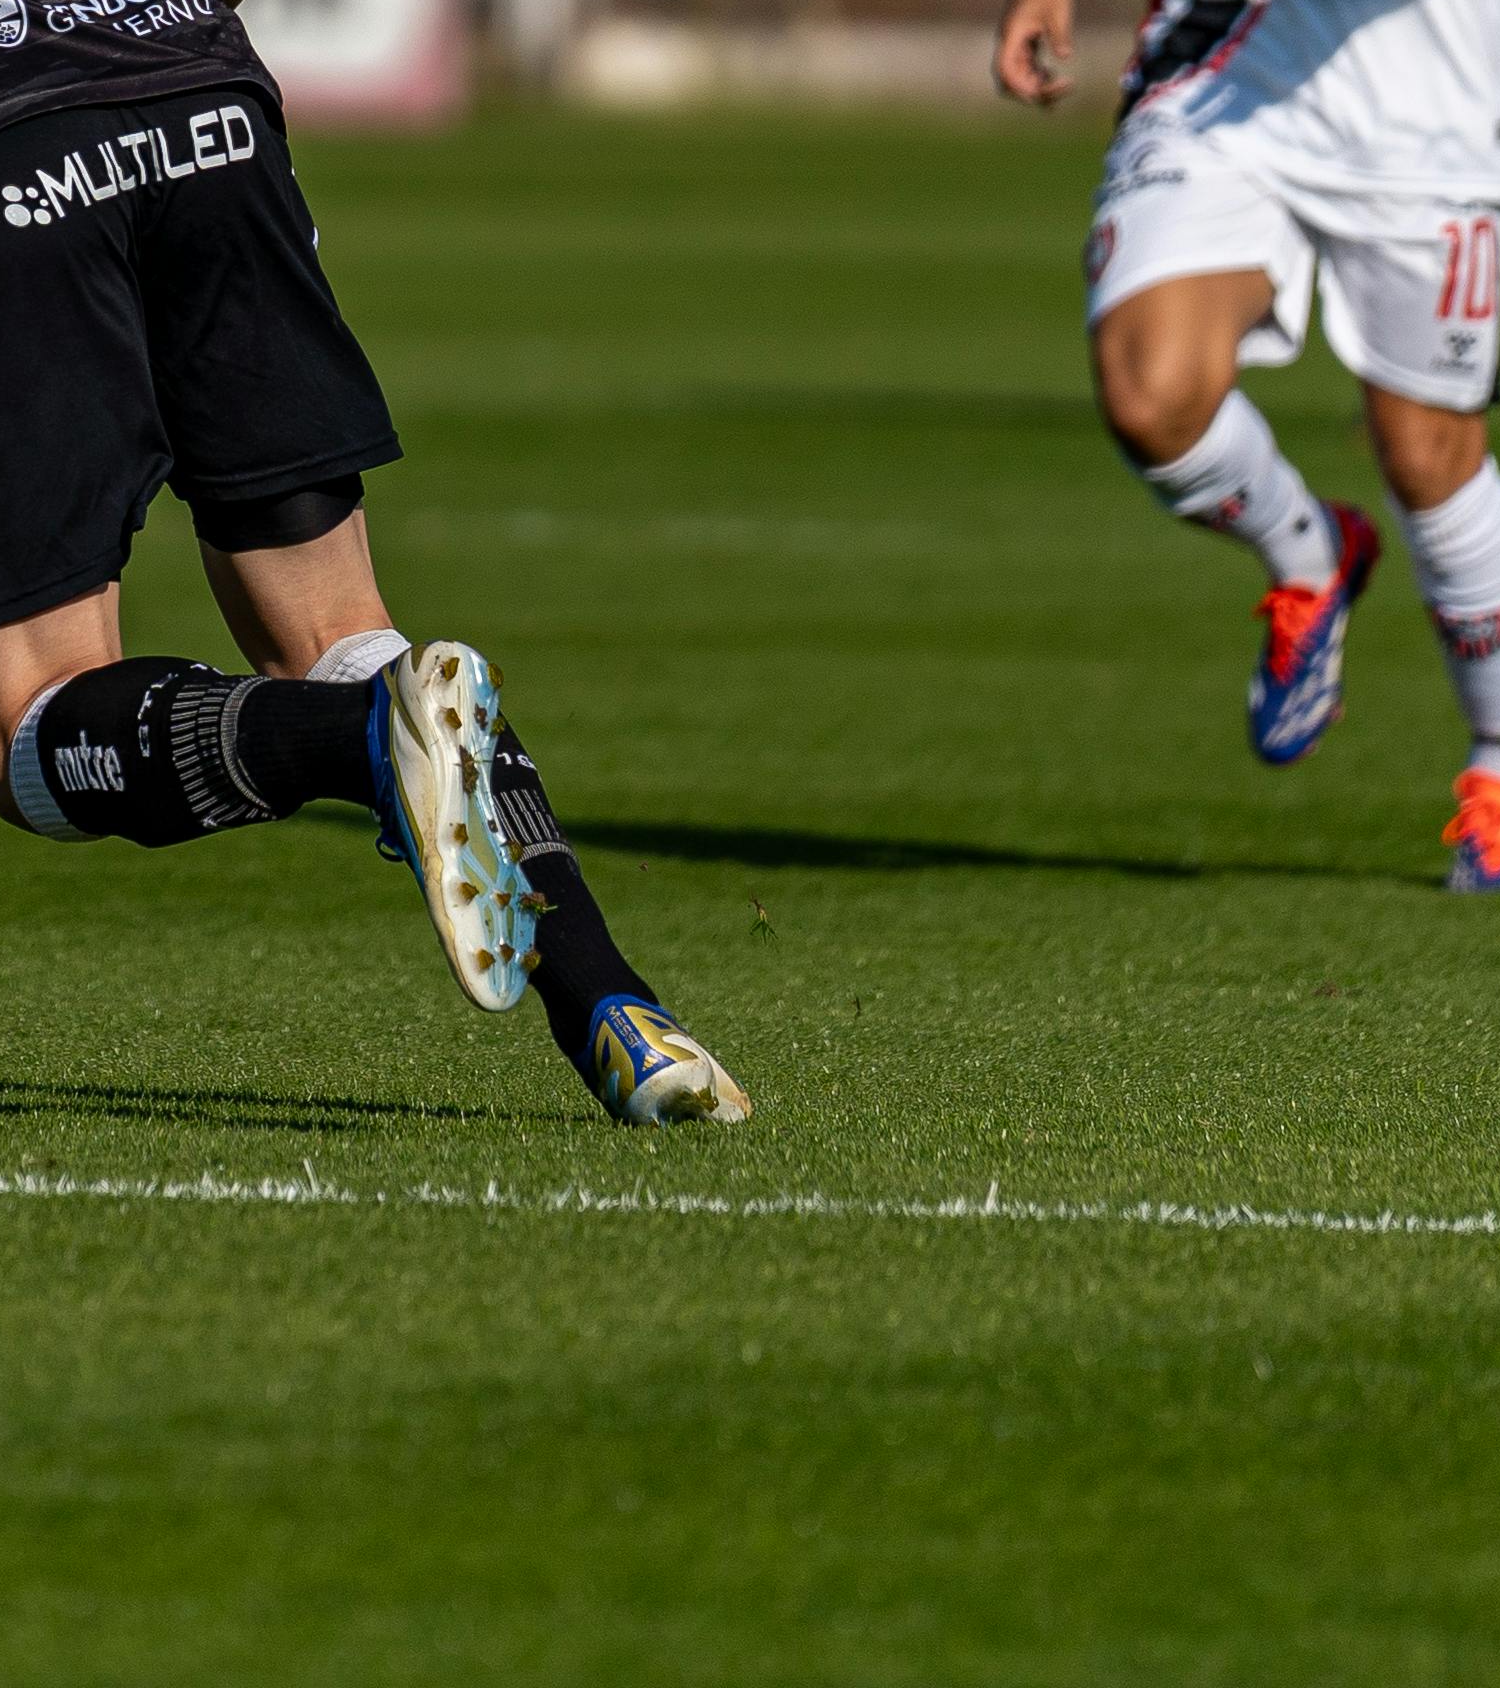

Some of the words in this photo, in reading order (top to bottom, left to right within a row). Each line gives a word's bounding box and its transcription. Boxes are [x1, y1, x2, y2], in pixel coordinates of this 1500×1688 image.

[35, 105, 255, 219] MULTILED
[1434, 214, 1498, 320] 10
[54, 729, 126, 792] mitre
